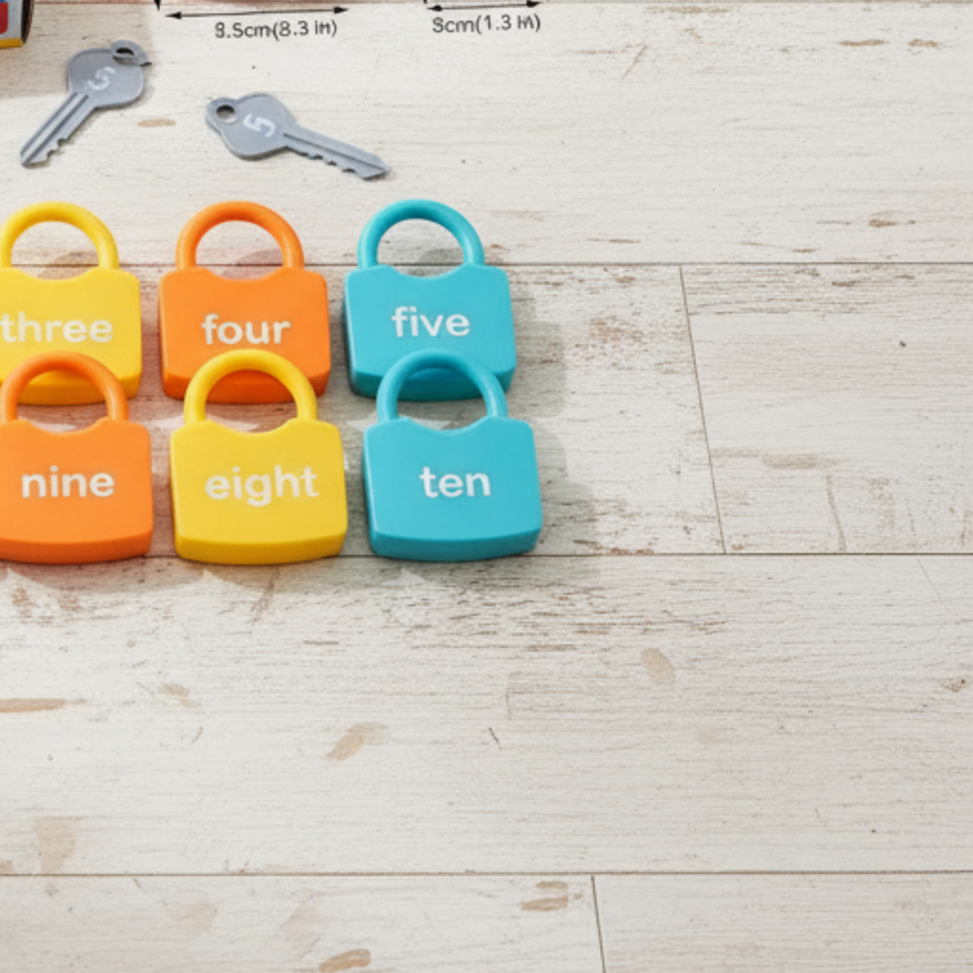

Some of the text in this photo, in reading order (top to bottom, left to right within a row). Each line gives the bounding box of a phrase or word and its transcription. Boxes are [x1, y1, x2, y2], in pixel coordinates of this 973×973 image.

[0, 312, 114, 343] three
[201, 313, 291, 345] four
[391, 306, 470, 337] five
[21, 466, 115, 499] nine
[204, 465, 320, 507] eight
[419, 466, 491, 498] ten
